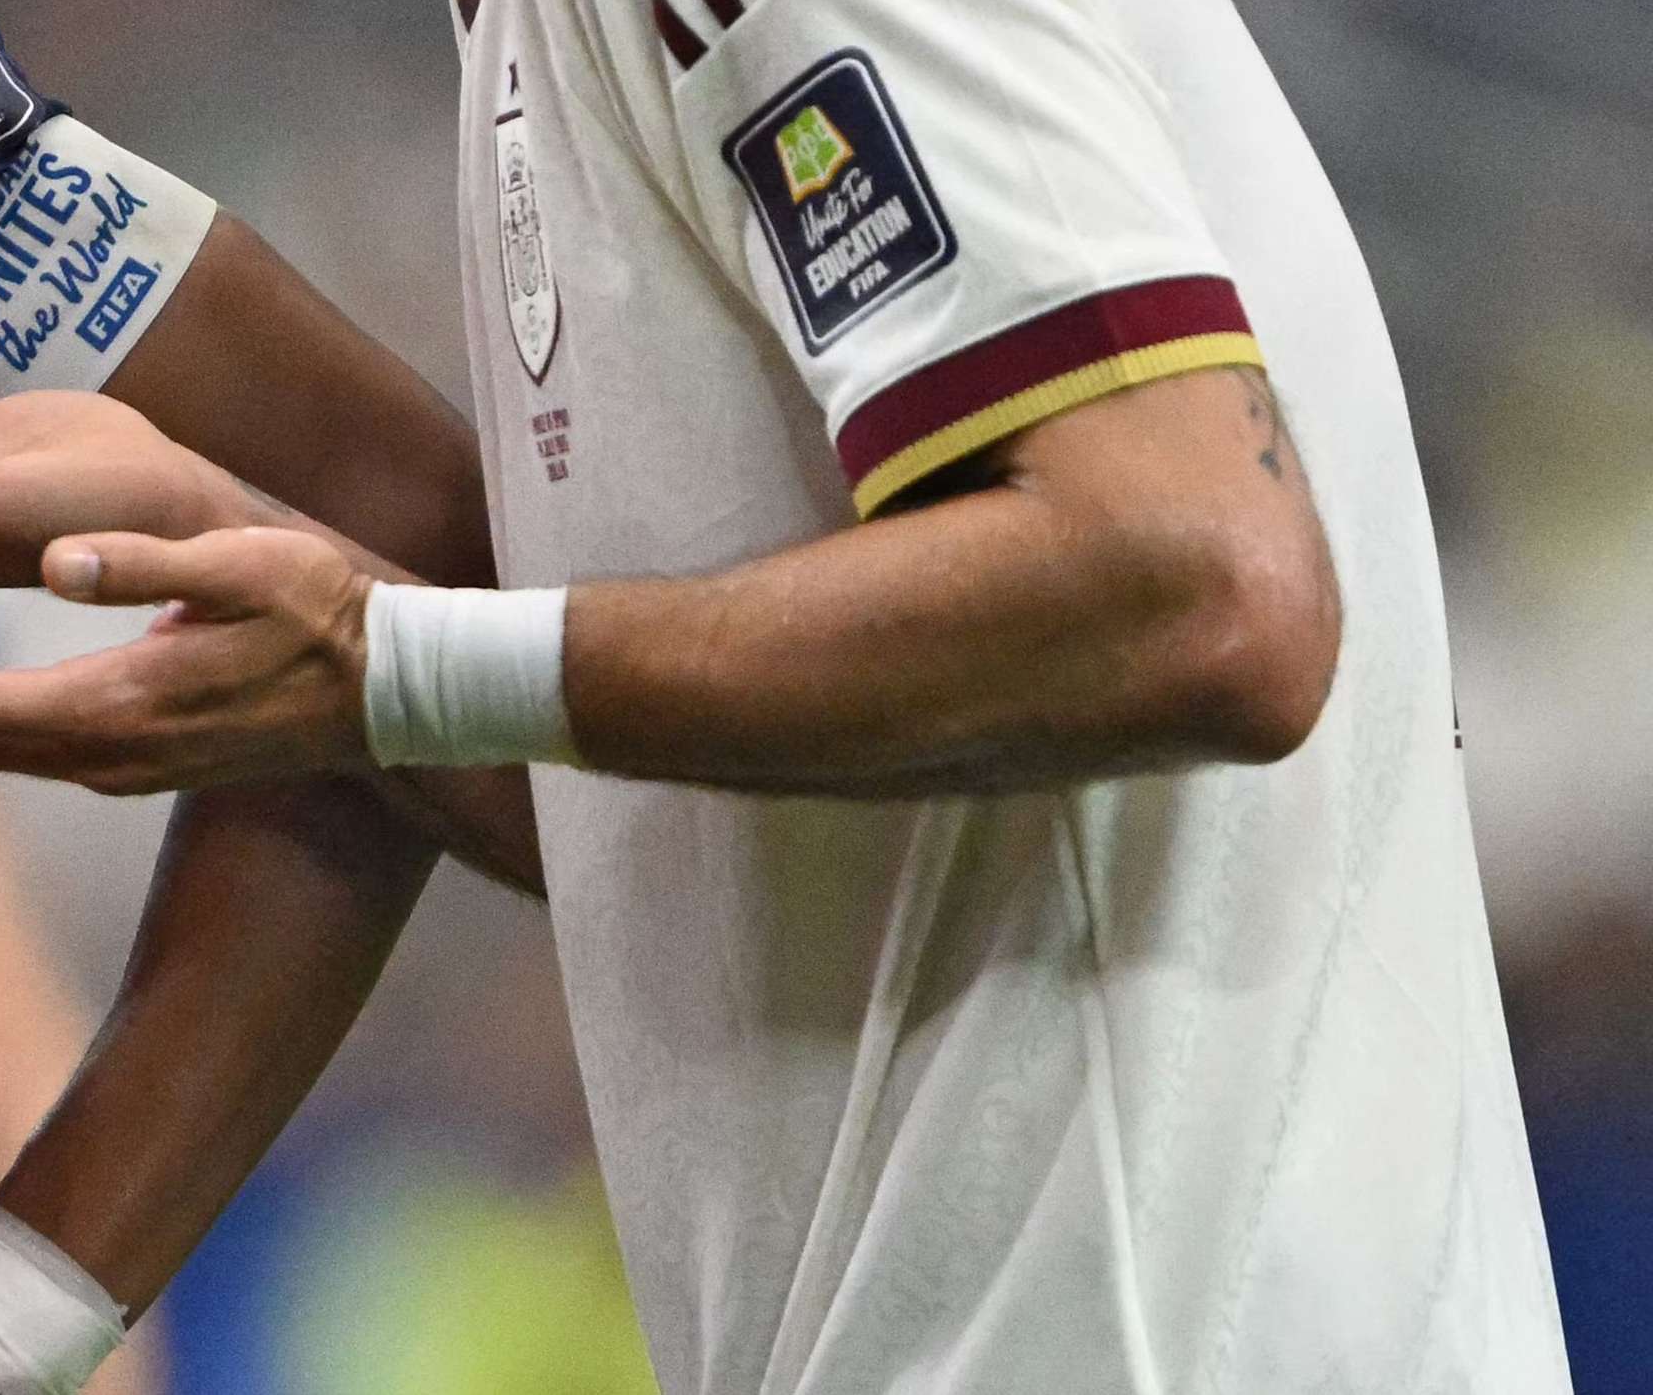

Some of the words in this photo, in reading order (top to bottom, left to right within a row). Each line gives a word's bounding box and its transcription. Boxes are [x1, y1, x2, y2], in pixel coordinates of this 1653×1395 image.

[39, 172, 148, 304] World
[805, 195, 913, 299] EDUCATION
[849, 259, 891, 301] FIFA
[86, 272, 149, 340] FIFA
